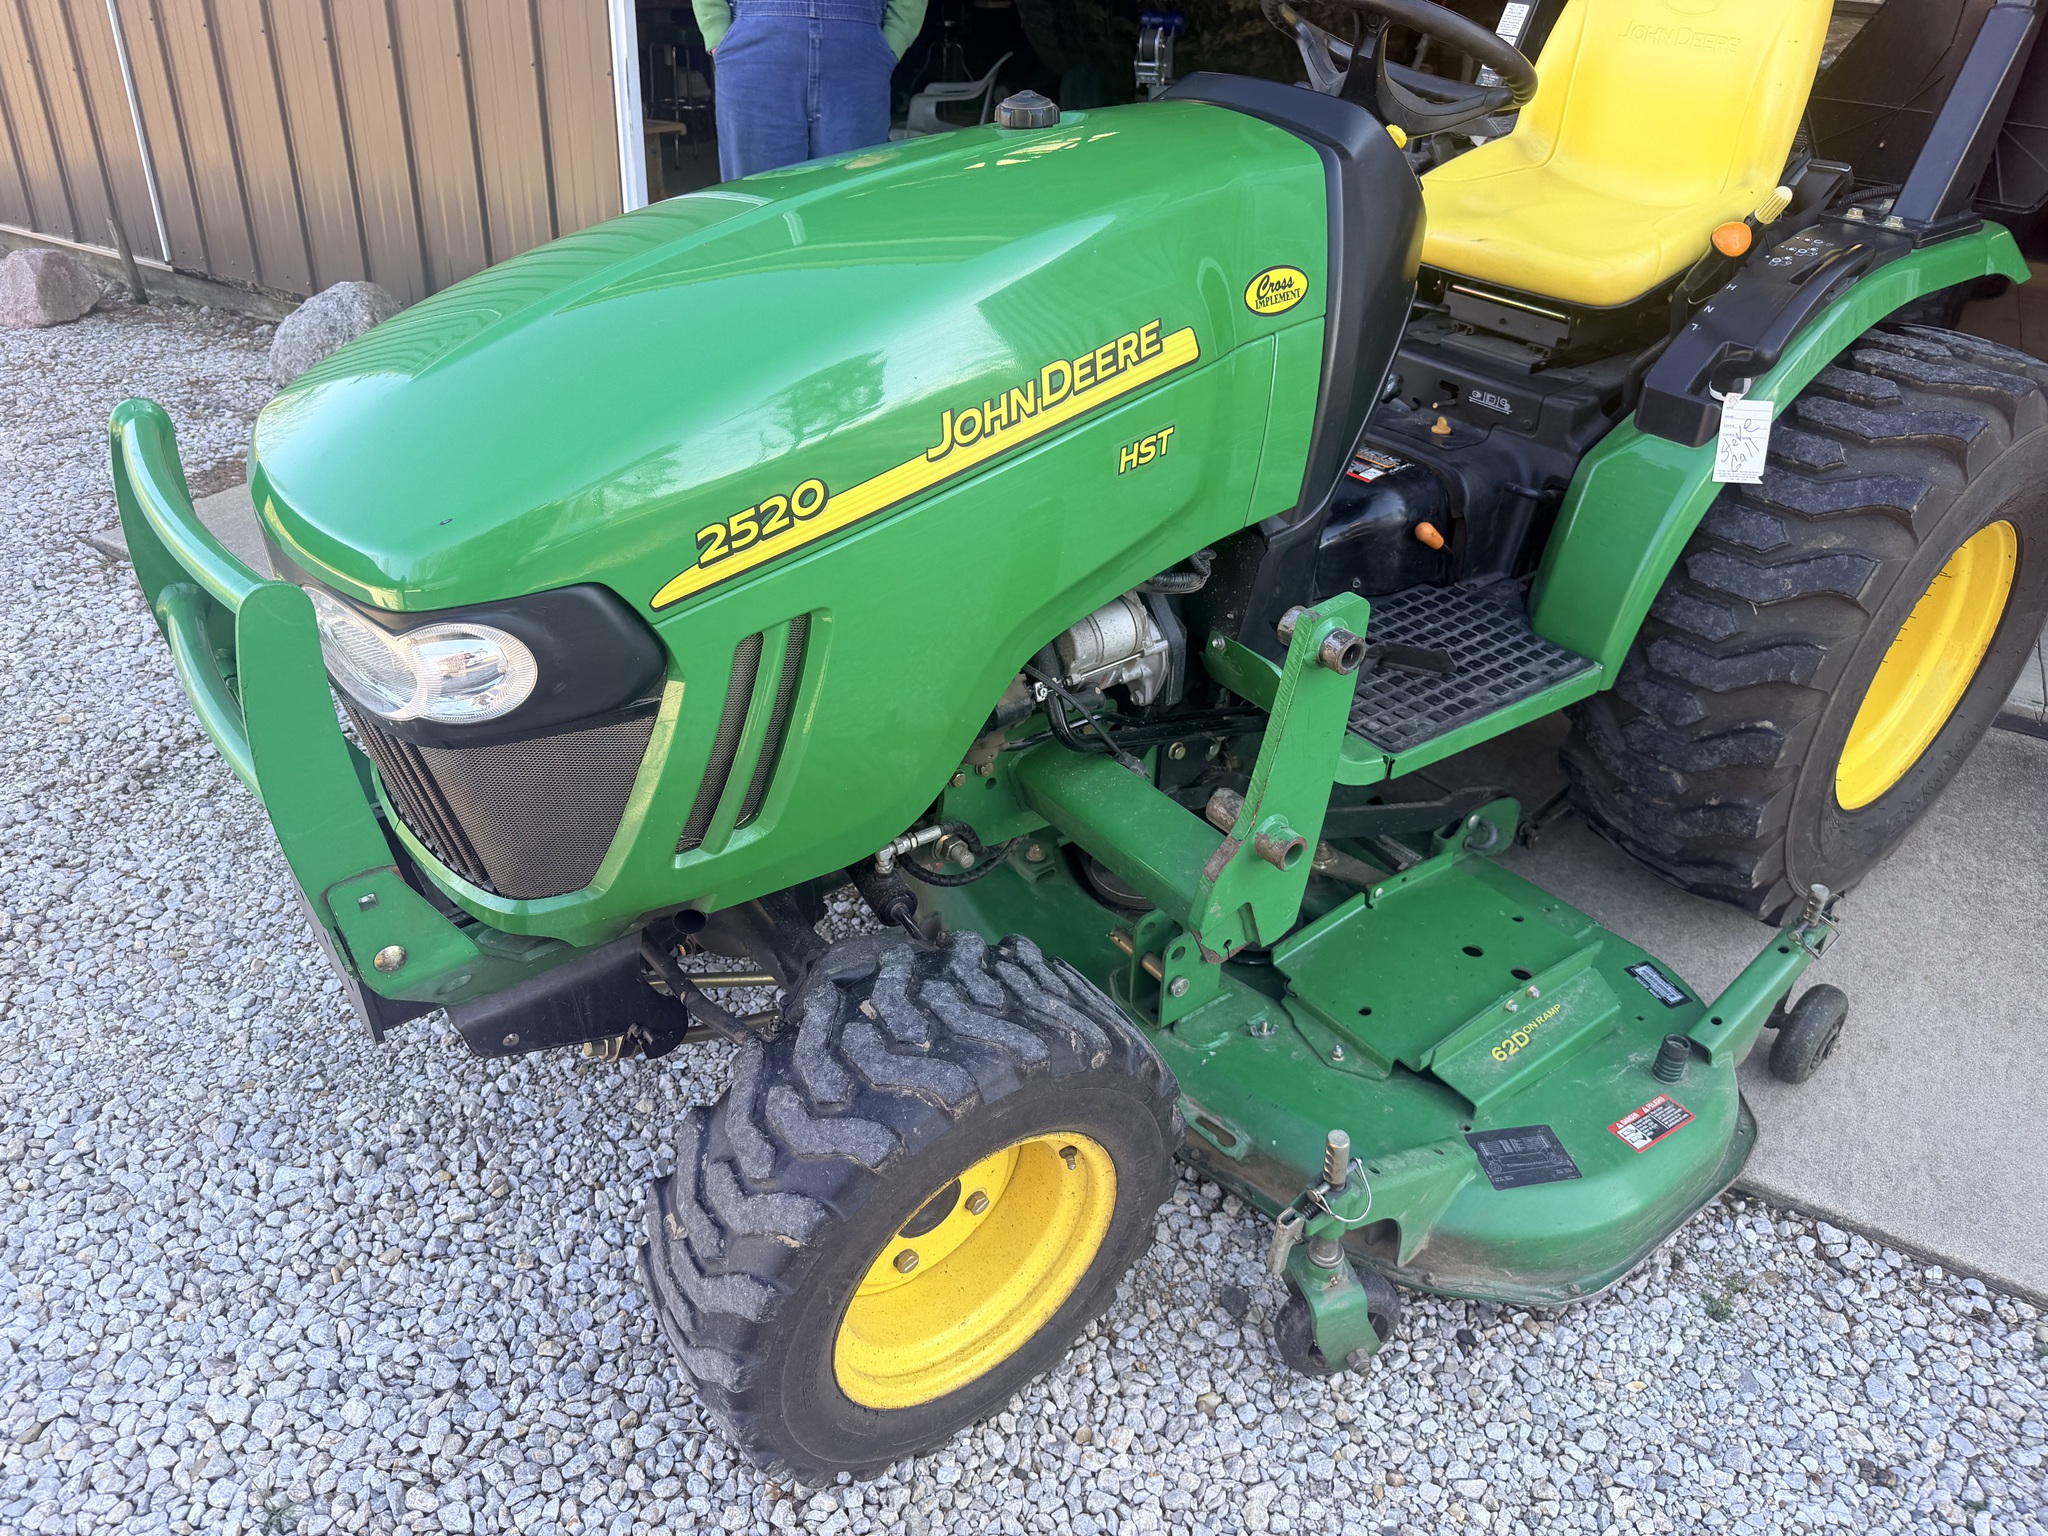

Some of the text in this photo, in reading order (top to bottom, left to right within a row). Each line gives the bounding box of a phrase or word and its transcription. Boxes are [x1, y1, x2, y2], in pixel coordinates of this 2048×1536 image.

[1616, 20, 1741, 54] JOHN DEERE
[1255, 288, 1301, 310] IMPLEMENT
[1256, 274, 1295, 301] Cross
[926, 318, 1163, 463] JOHN DEERE
[1117, 426, 1175, 476] HST
[695, 477, 829, 569] 2520
[1491, 1003, 1561, 1062] 62D ON RAMP
